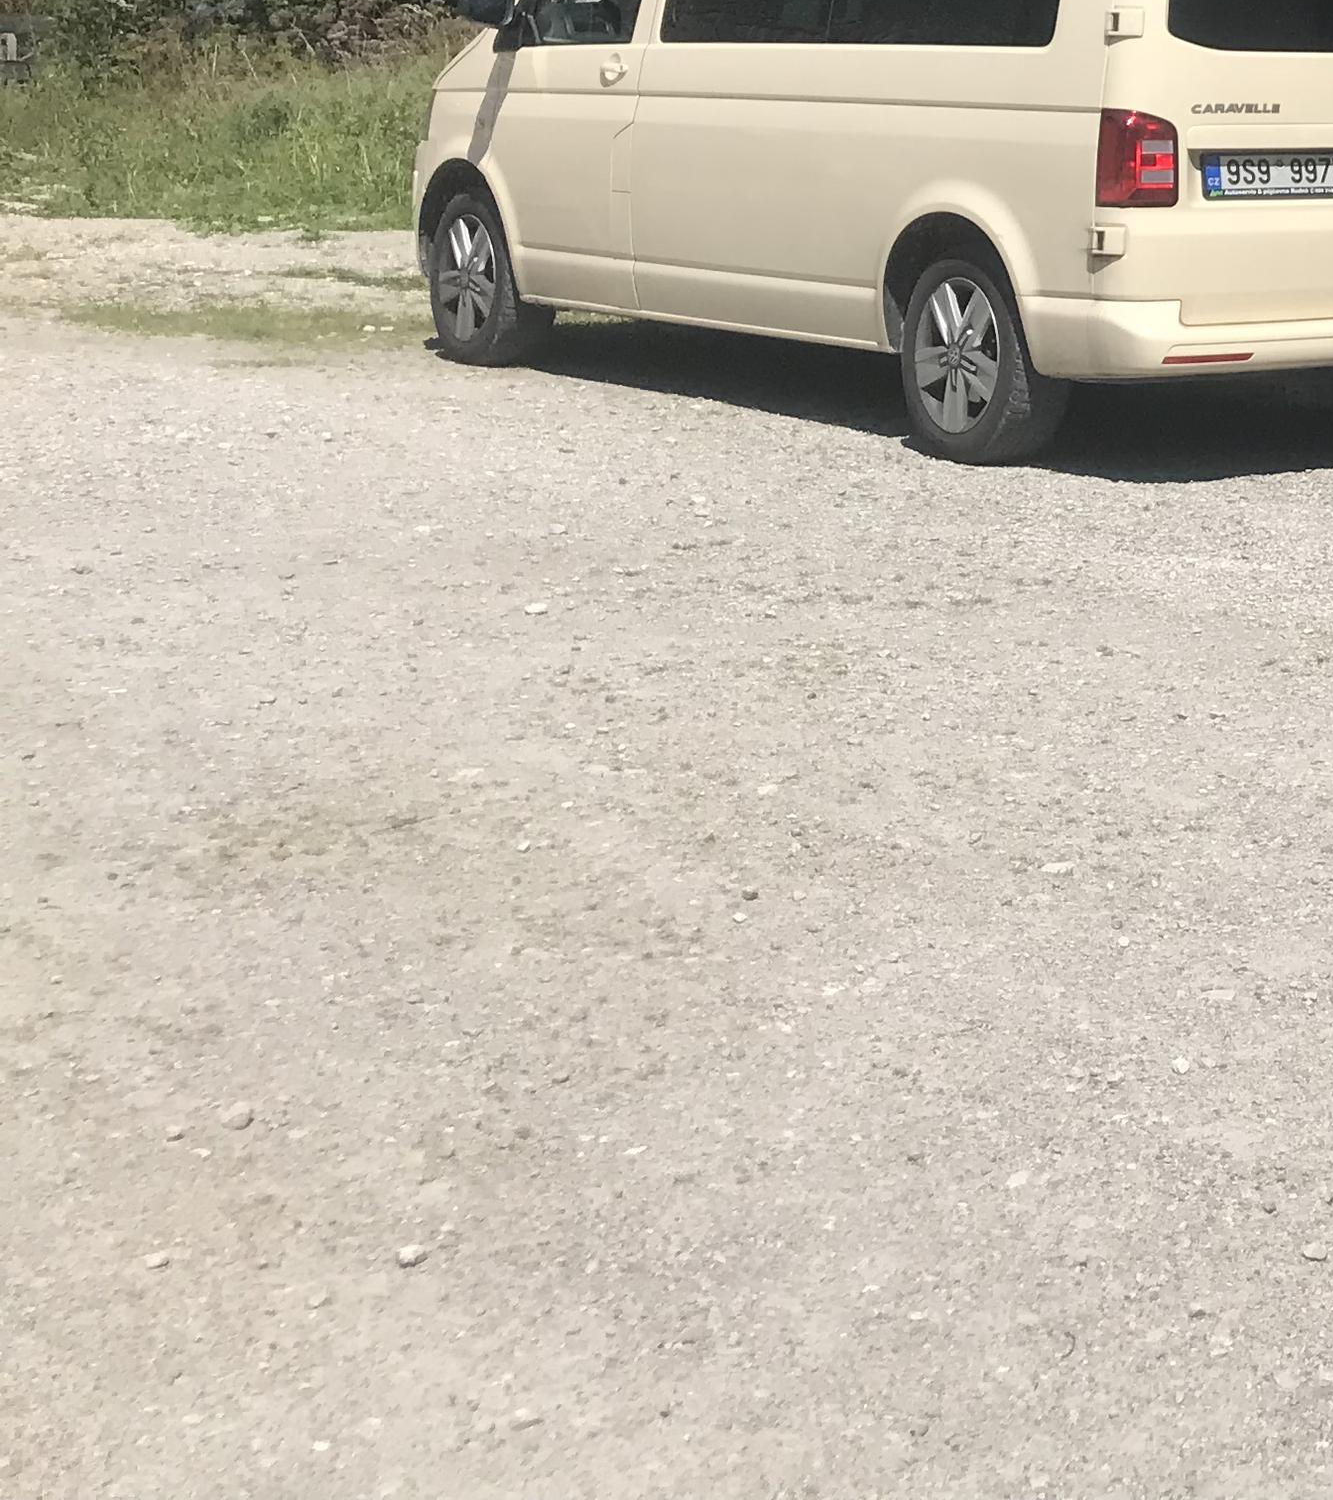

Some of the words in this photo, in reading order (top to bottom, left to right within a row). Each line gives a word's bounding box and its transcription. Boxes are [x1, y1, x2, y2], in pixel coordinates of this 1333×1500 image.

[1191, 103, 1281, 114] CARAVELLE
[1226, 159, 1271, 185] 9S9
[1207, 177, 1221, 186] CZ
